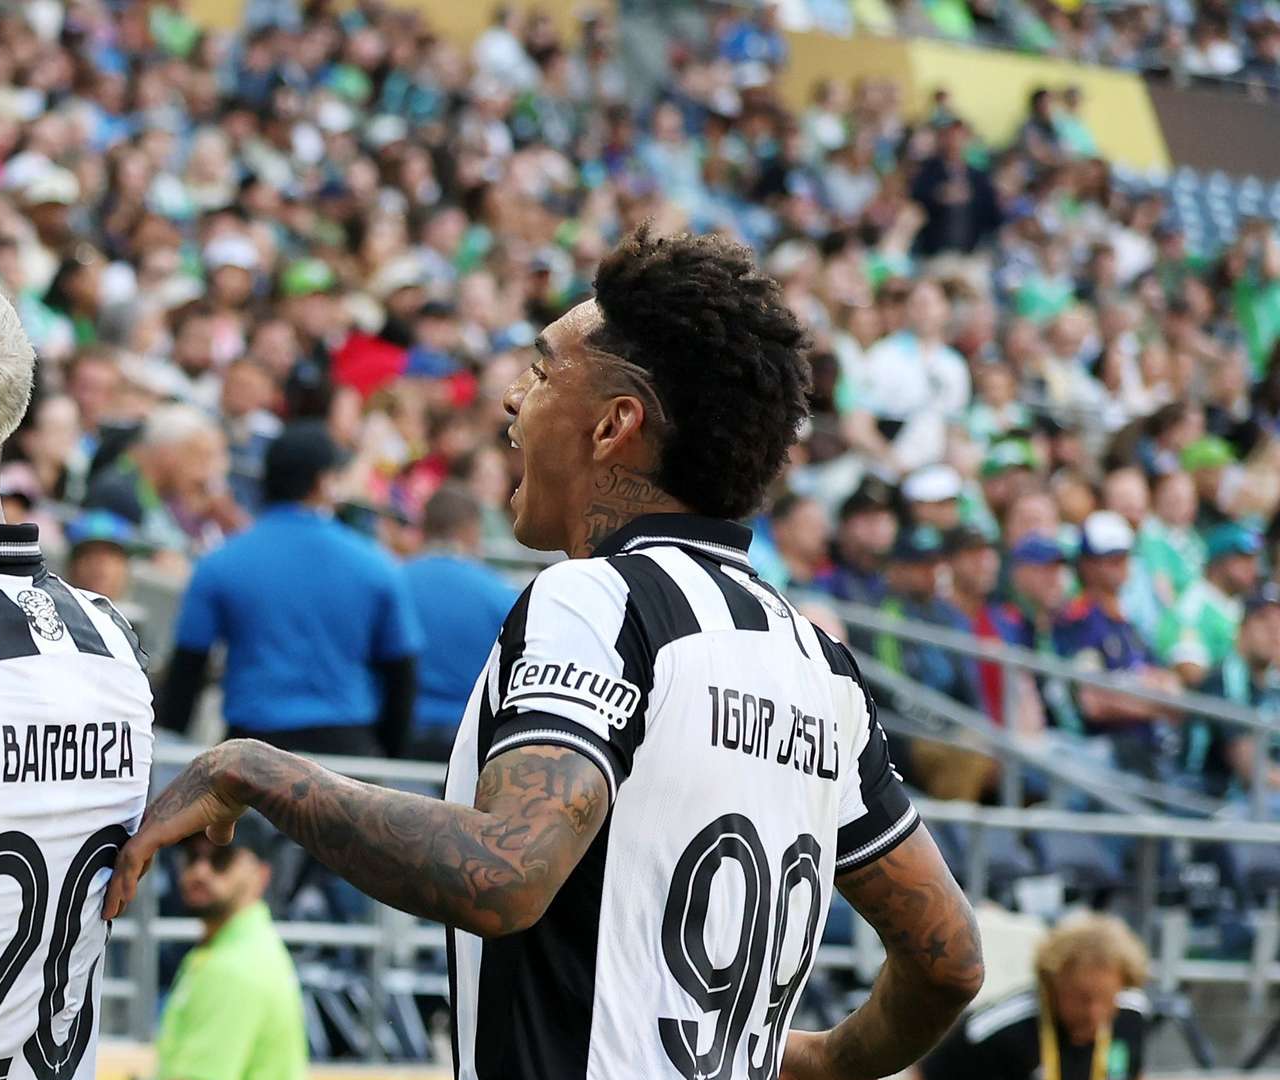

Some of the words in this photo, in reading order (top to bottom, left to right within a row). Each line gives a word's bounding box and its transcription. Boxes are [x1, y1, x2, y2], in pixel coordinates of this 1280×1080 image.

[510, 662, 637, 712] Centrum
[2, 721, 135, 783] BARBOZA
[708, 686, 775, 760] IGOR
